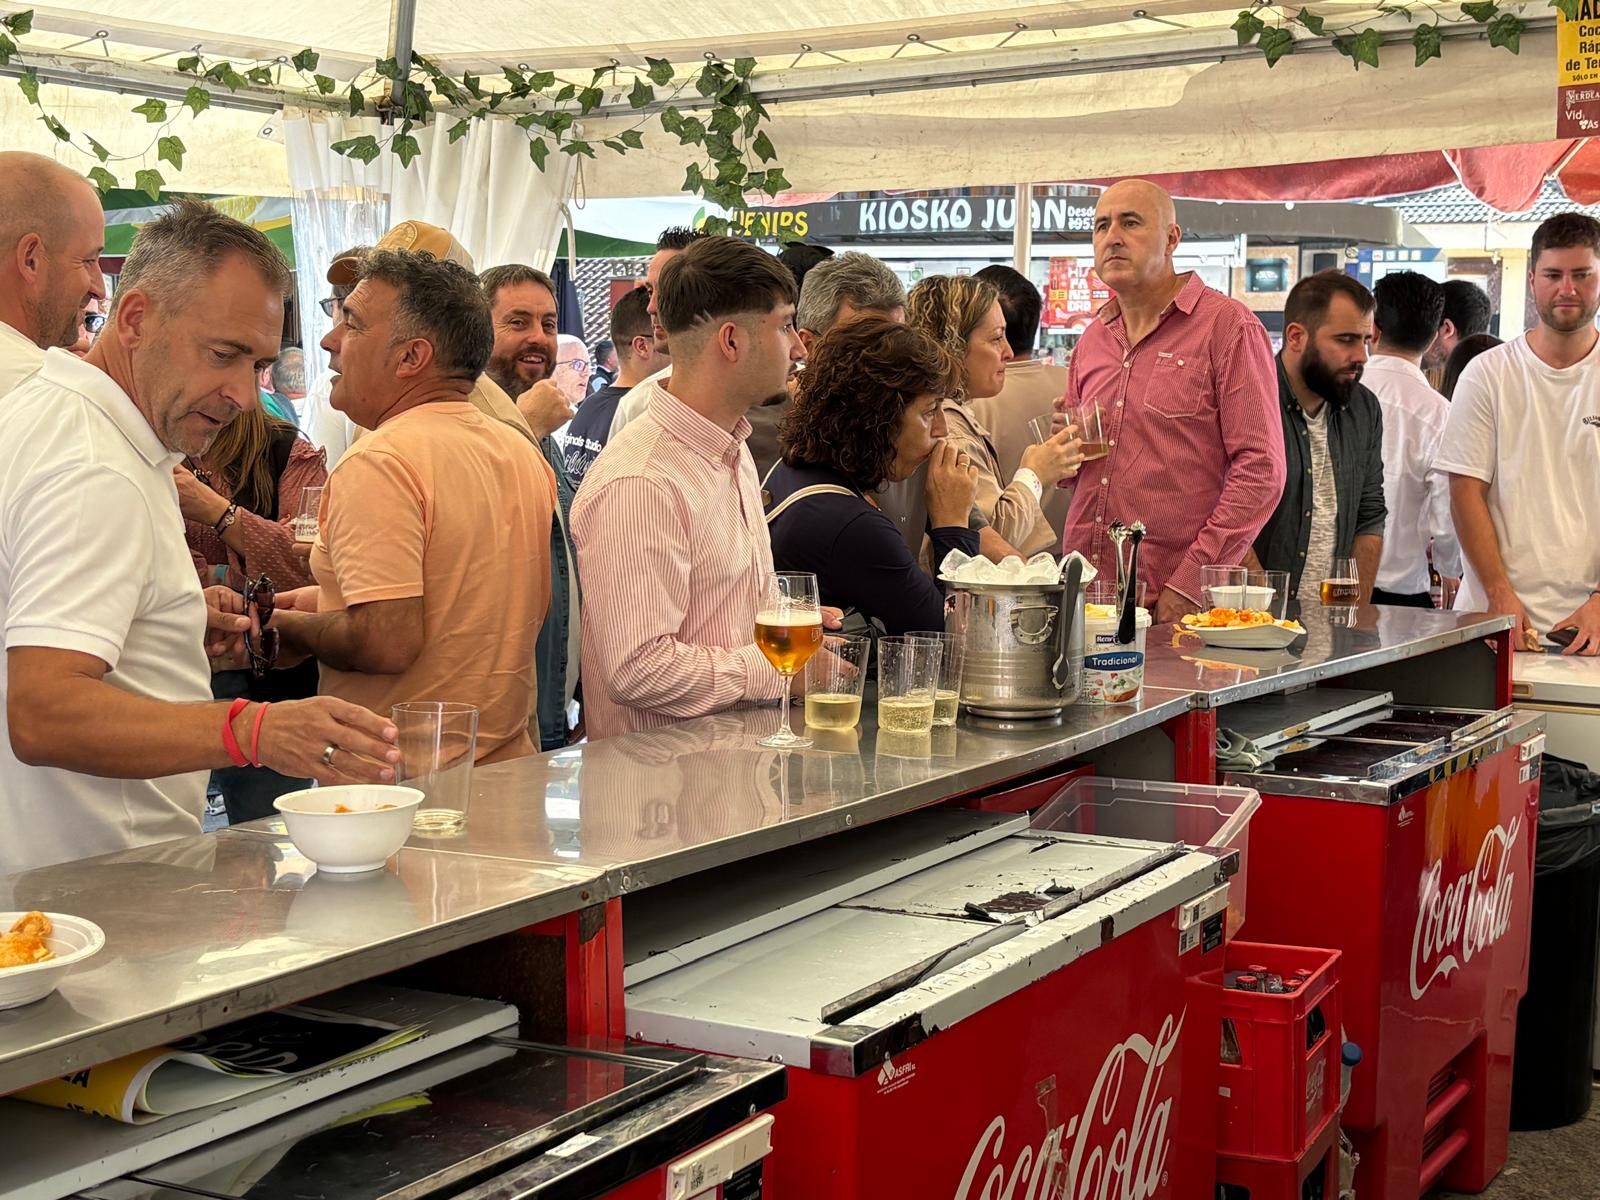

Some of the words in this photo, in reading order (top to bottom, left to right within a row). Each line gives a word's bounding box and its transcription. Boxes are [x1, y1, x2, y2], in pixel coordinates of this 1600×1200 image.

[1565, 59, 1581, 71] de
[1584, 57, 1600, 70] Te
[859, 199, 973, 232] KIOSKO
[1067, 206, 1096, 217] Desd
[1092, 655, 1138, 666] Tradicional
[1410, 812, 1522, 1000] Coca-Cola
